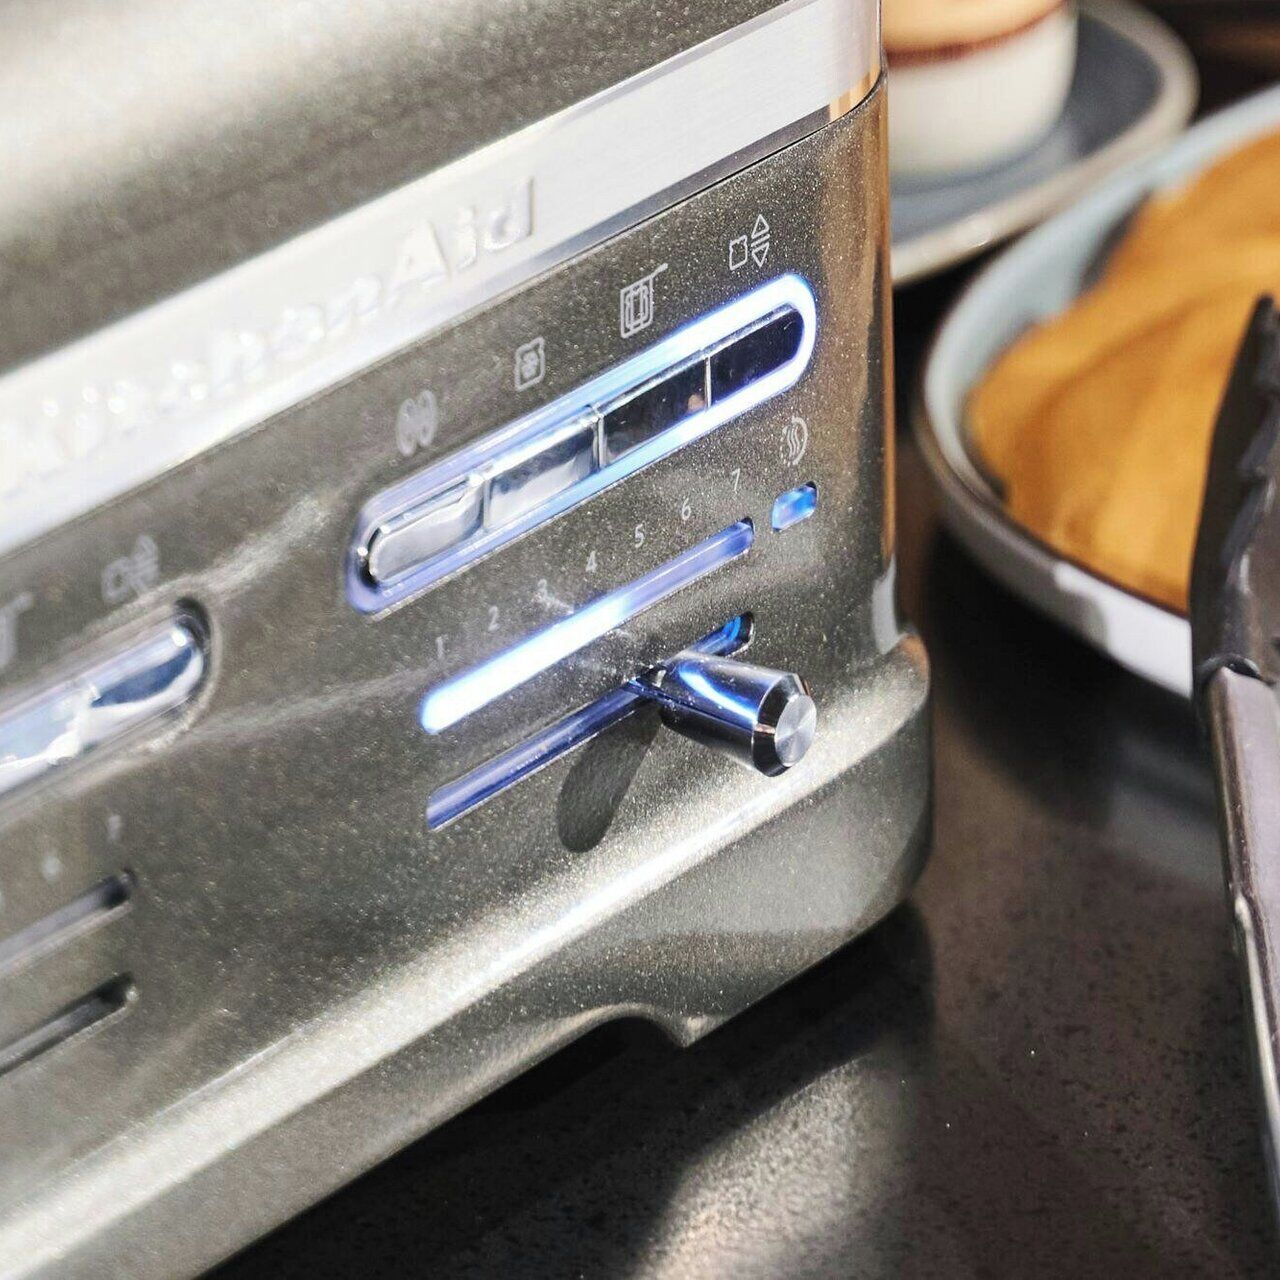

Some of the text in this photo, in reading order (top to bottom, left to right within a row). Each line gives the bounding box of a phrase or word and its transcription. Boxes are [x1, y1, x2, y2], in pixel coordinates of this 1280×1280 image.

[487, 604, 501, 633] 2
[584, 549, 599, 573] 4
[633, 522, 646, 549] 5
[680, 497, 693, 521] 6
[730, 467, 742, 492] 7
